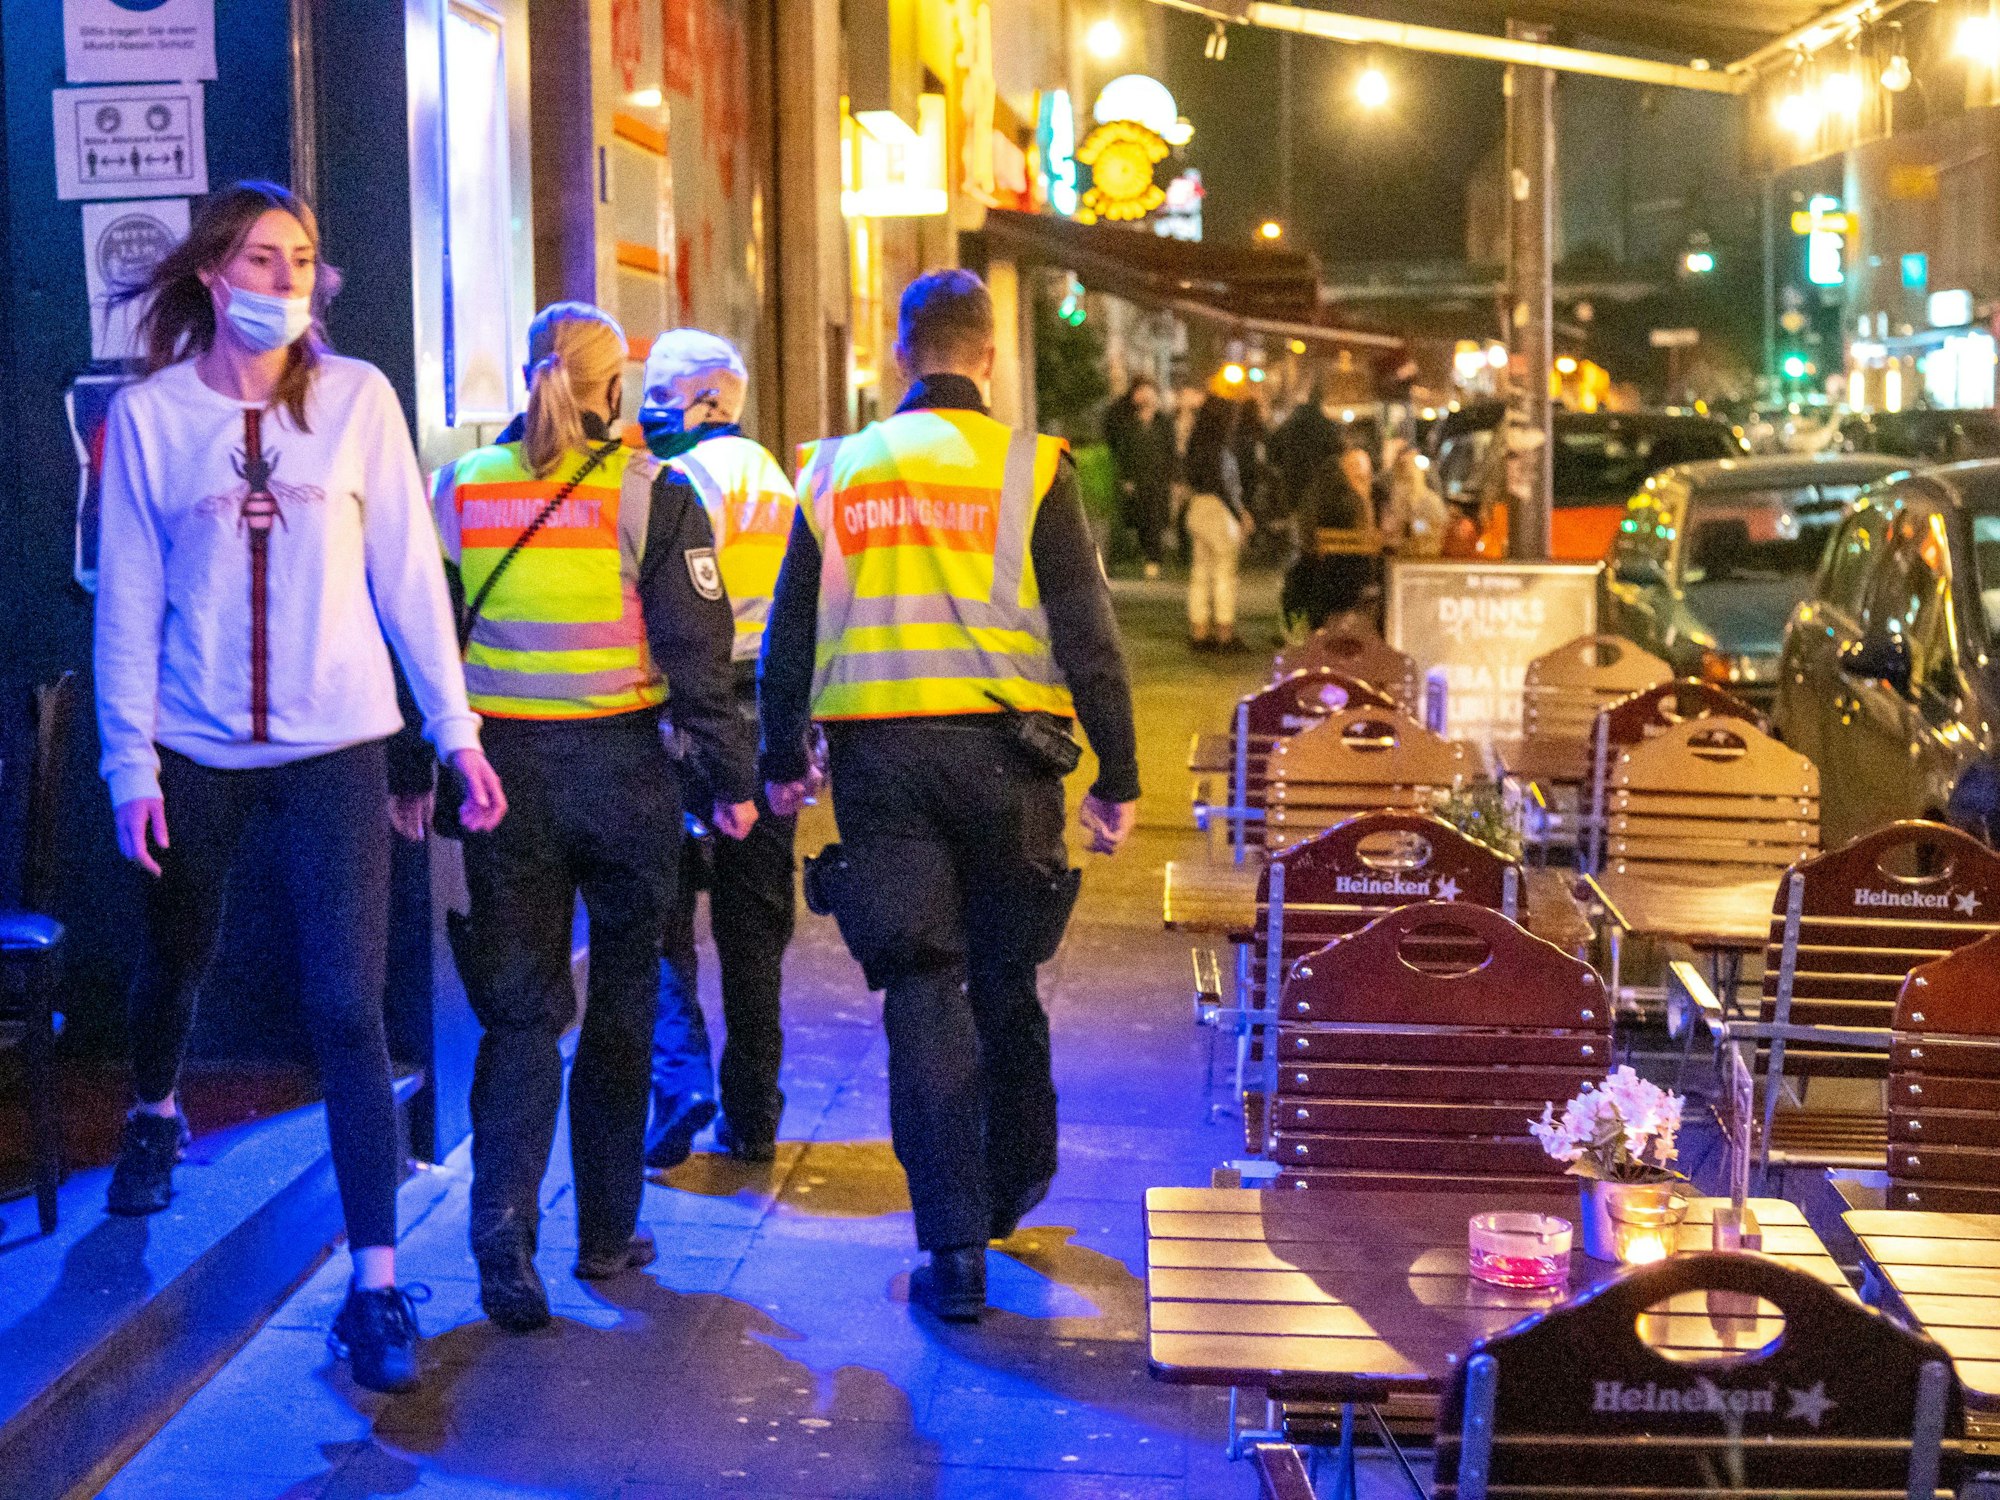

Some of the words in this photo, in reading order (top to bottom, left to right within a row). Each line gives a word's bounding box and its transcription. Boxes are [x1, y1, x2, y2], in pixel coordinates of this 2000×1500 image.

[1439, 596, 1545, 624] DRINKS
[1335, 873, 1431, 896] Heineken
[1854, 888, 1950, 908] Heineken
[1592, 1379, 1775, 1413] Heineken
